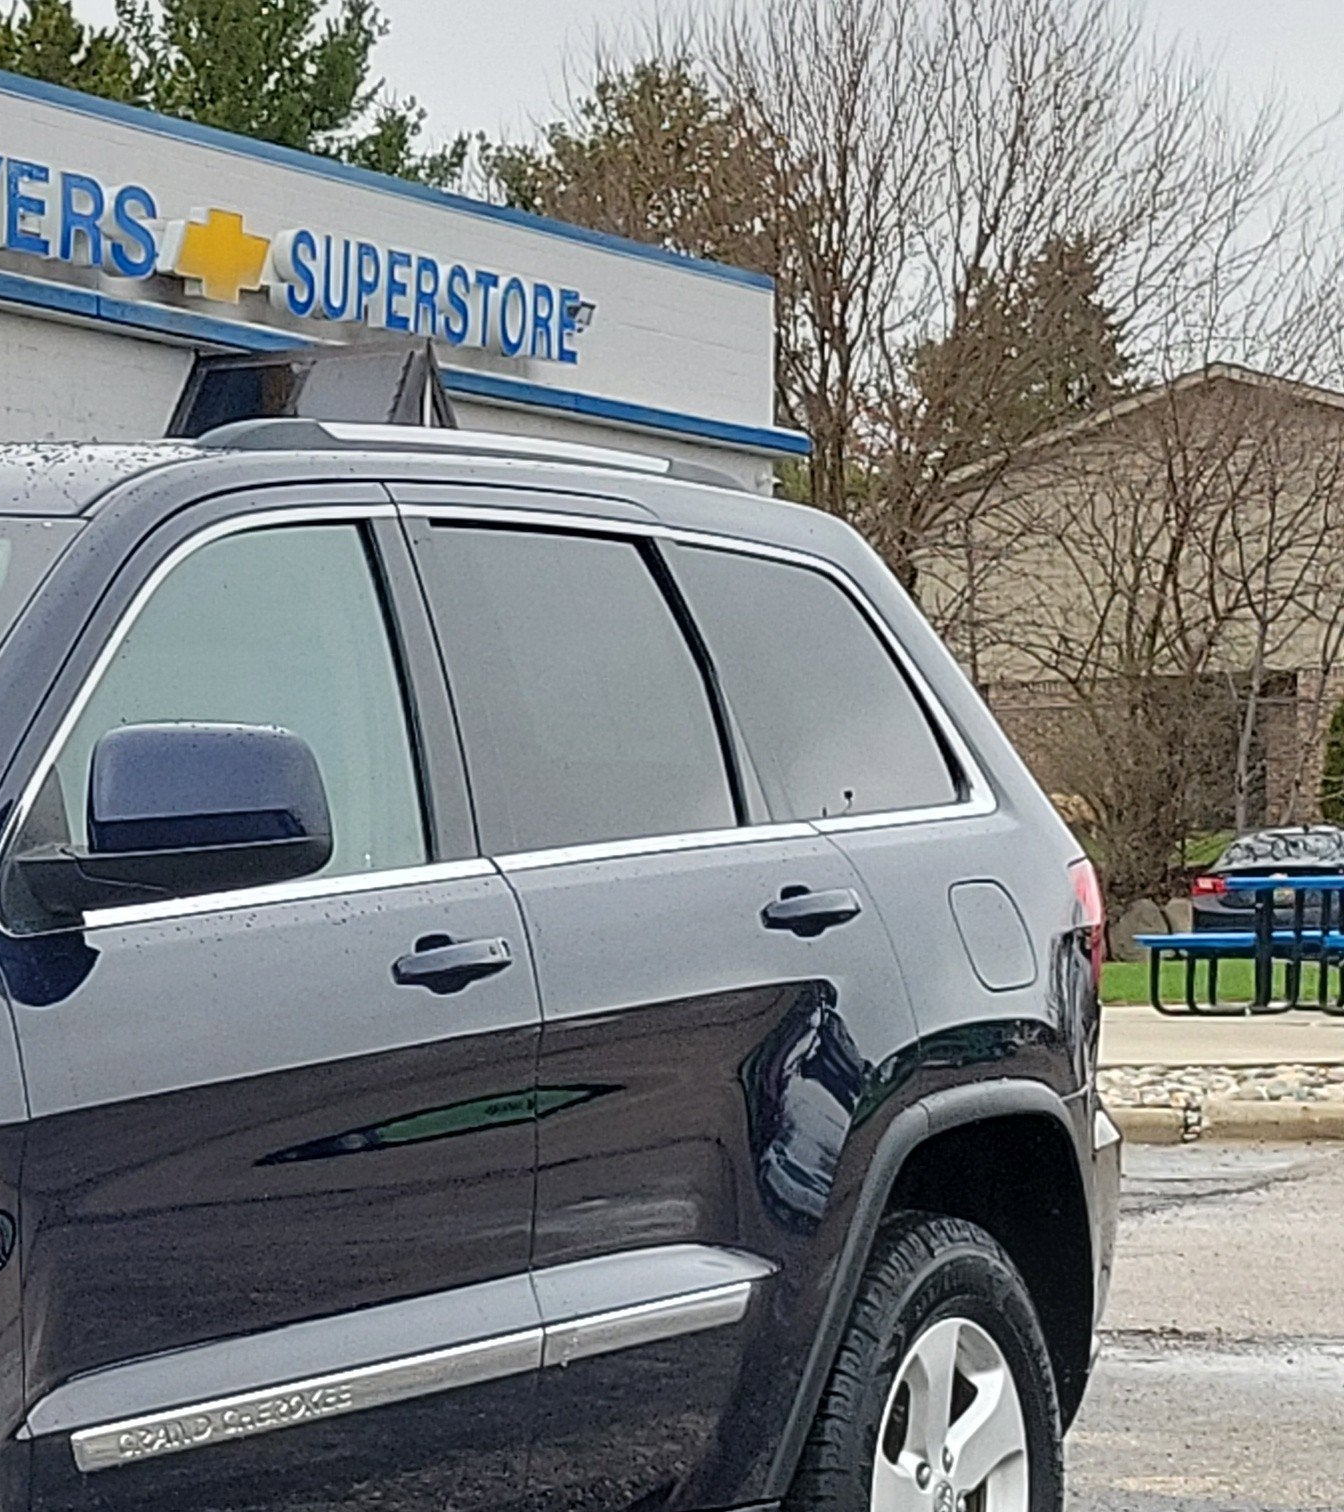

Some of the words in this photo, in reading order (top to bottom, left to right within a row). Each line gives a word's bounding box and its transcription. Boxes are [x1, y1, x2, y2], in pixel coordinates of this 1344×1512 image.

[285, 228, 583, 365] SUPERSTORE
[118, 1413, 212, 1458] GRAND
[223, 1384, 354, 1435] CHEROKEE
